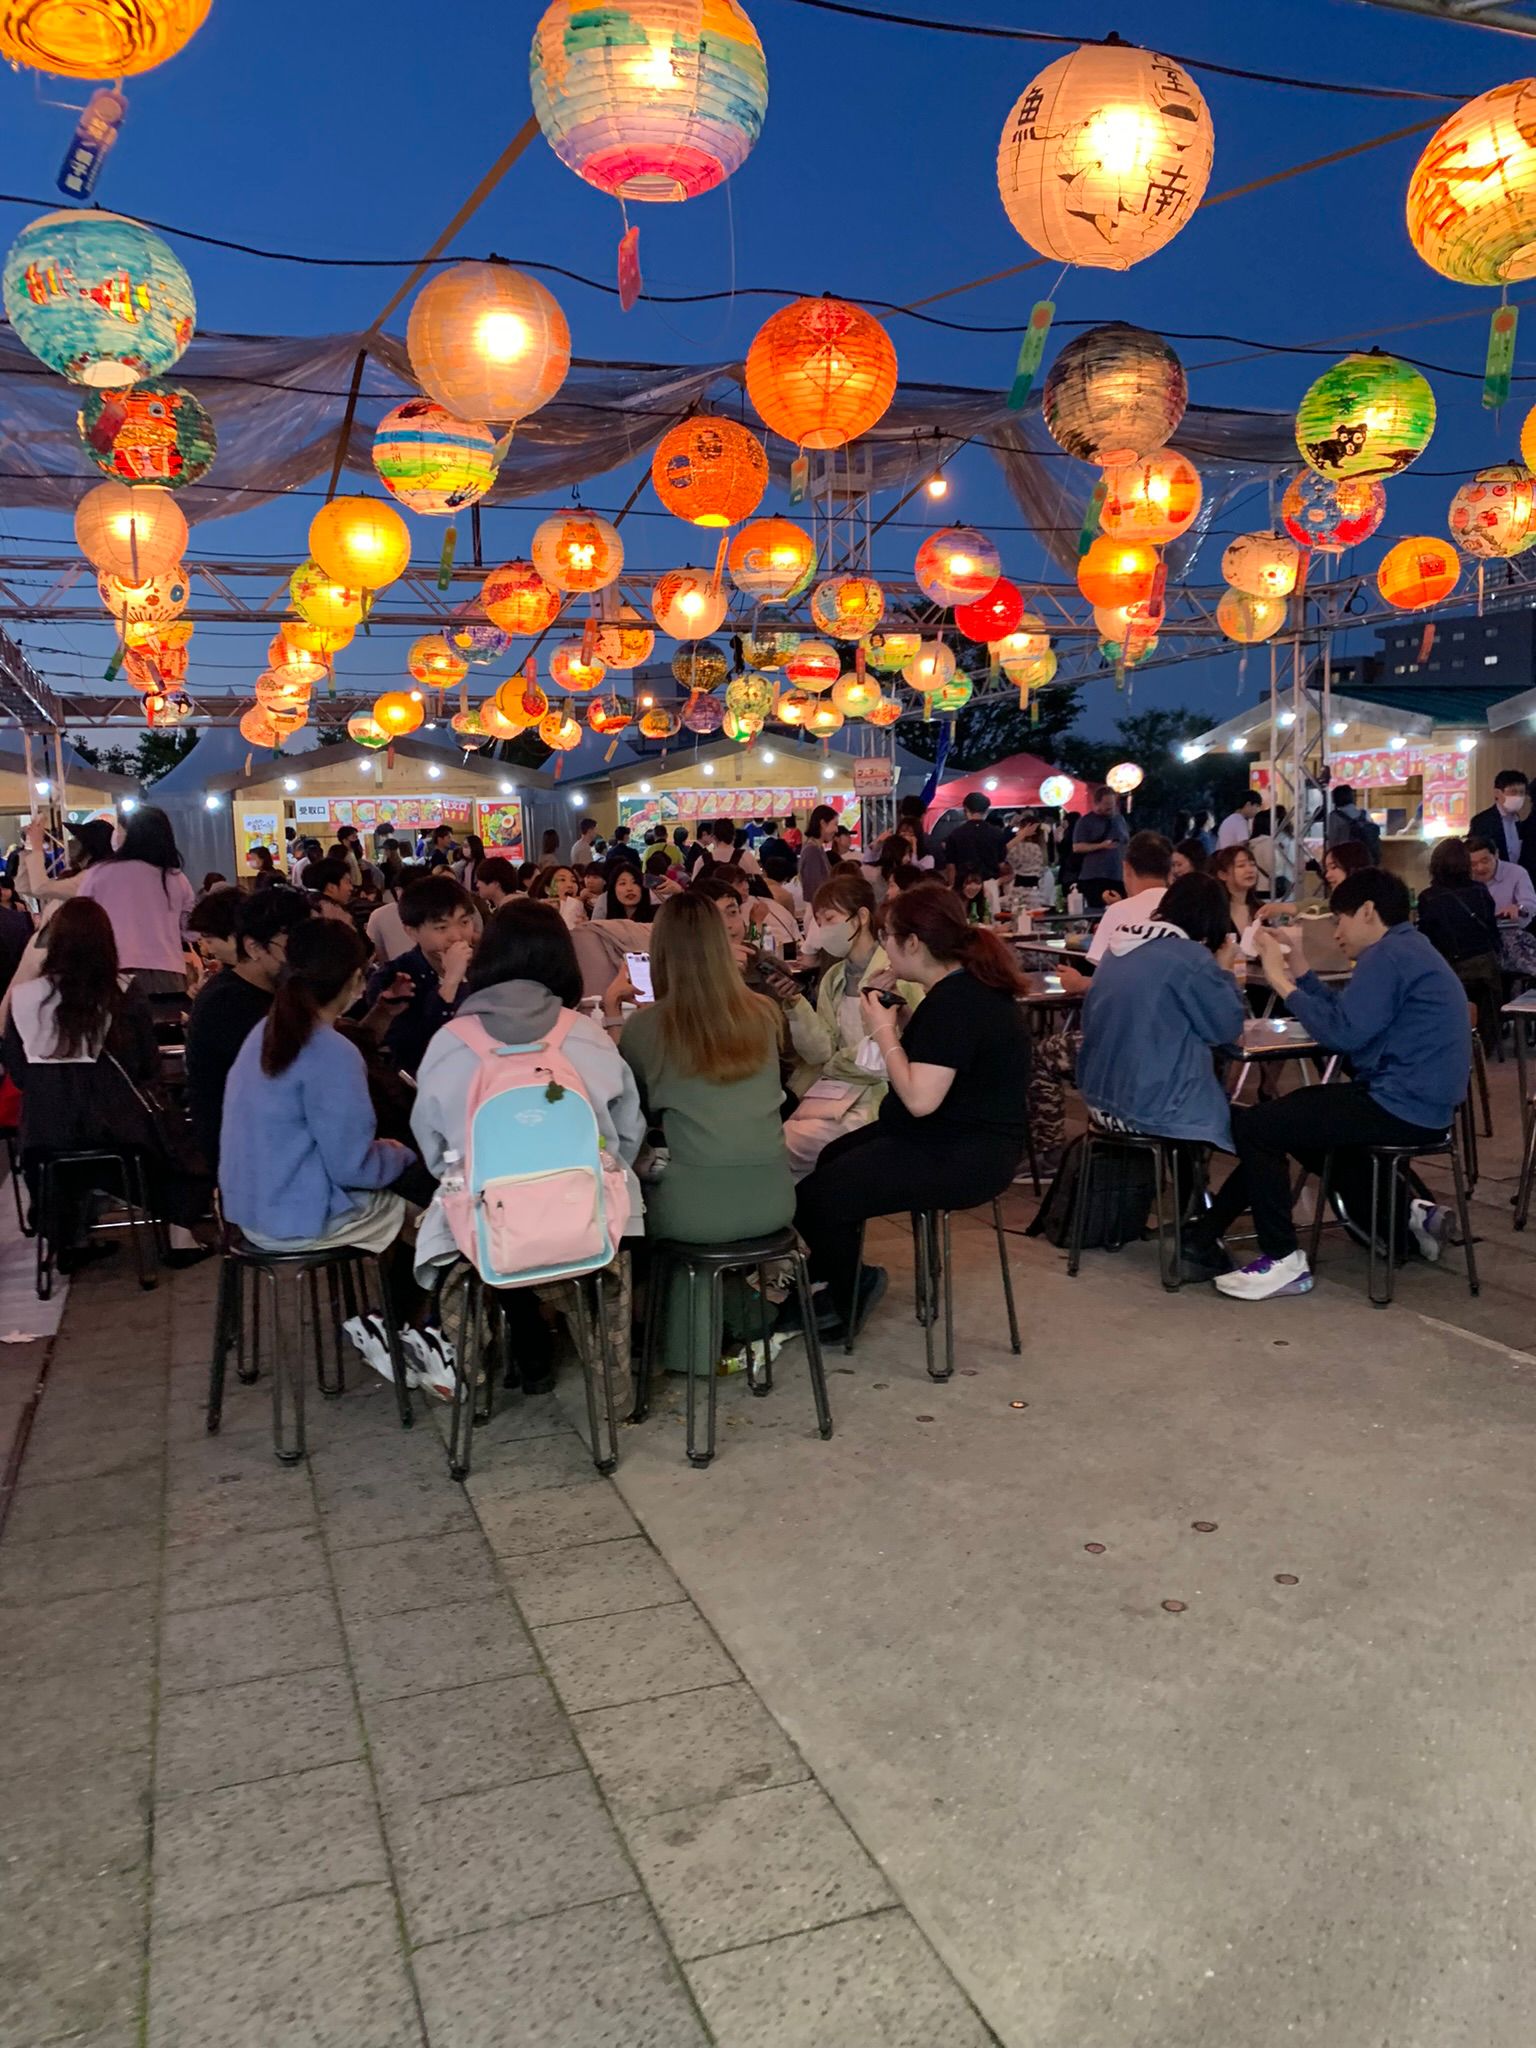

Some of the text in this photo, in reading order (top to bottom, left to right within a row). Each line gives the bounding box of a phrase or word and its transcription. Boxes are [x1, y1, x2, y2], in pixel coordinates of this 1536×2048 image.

[1142, 164, 1188, 220] 南
[299, 806, 326, 815] 受取口
